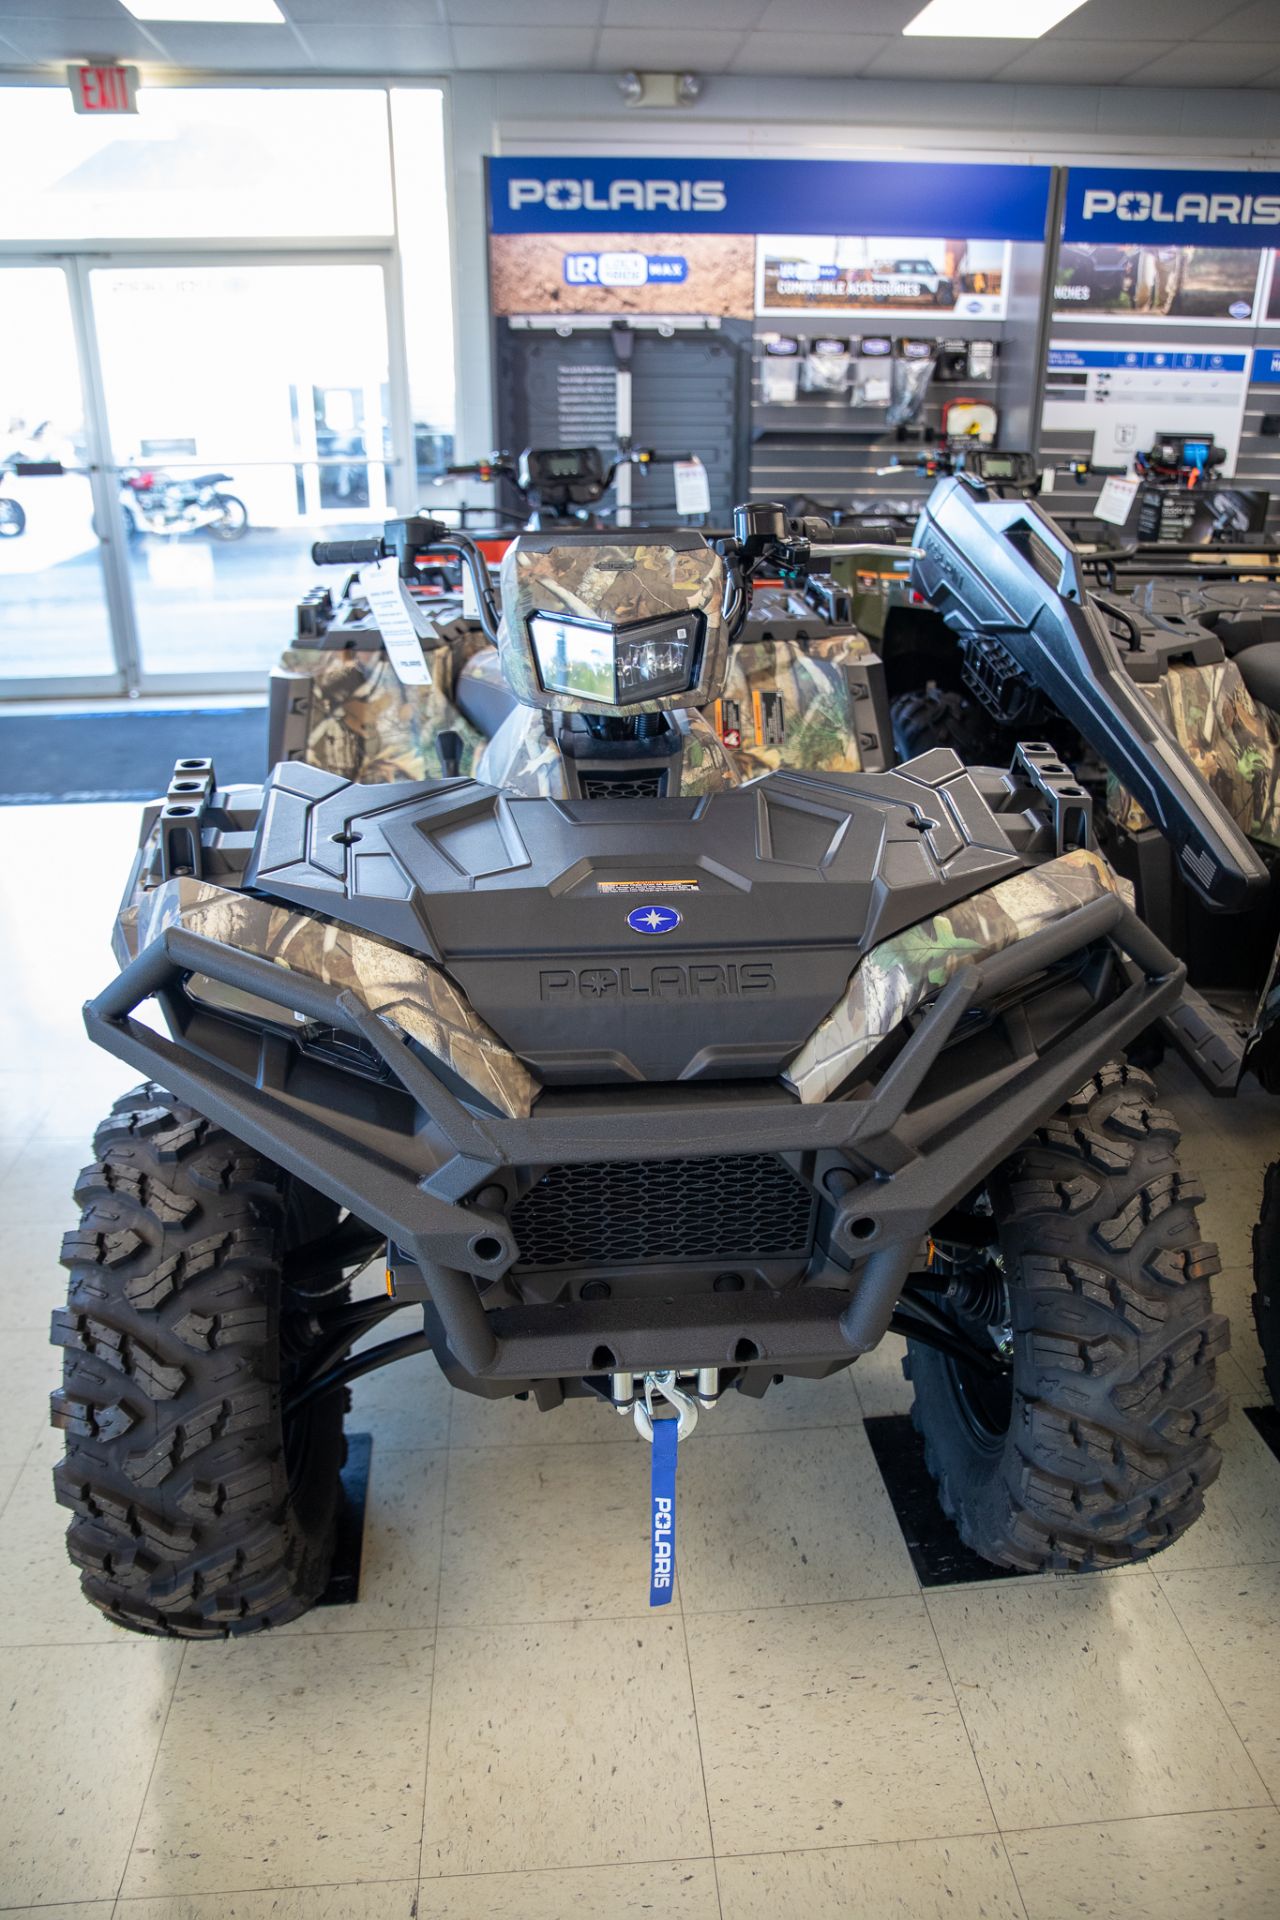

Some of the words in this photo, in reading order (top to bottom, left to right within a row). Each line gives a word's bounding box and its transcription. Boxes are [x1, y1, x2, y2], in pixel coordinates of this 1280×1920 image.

[79, 66, 129, 110] EXIT
[508, 178, 727, 212] POLARIS
[1082, 189, 1280, 225] POLARIS
[539, 962, 777, 1001] POLARIS
[654, 1497, 672, 1589] POLARIS
